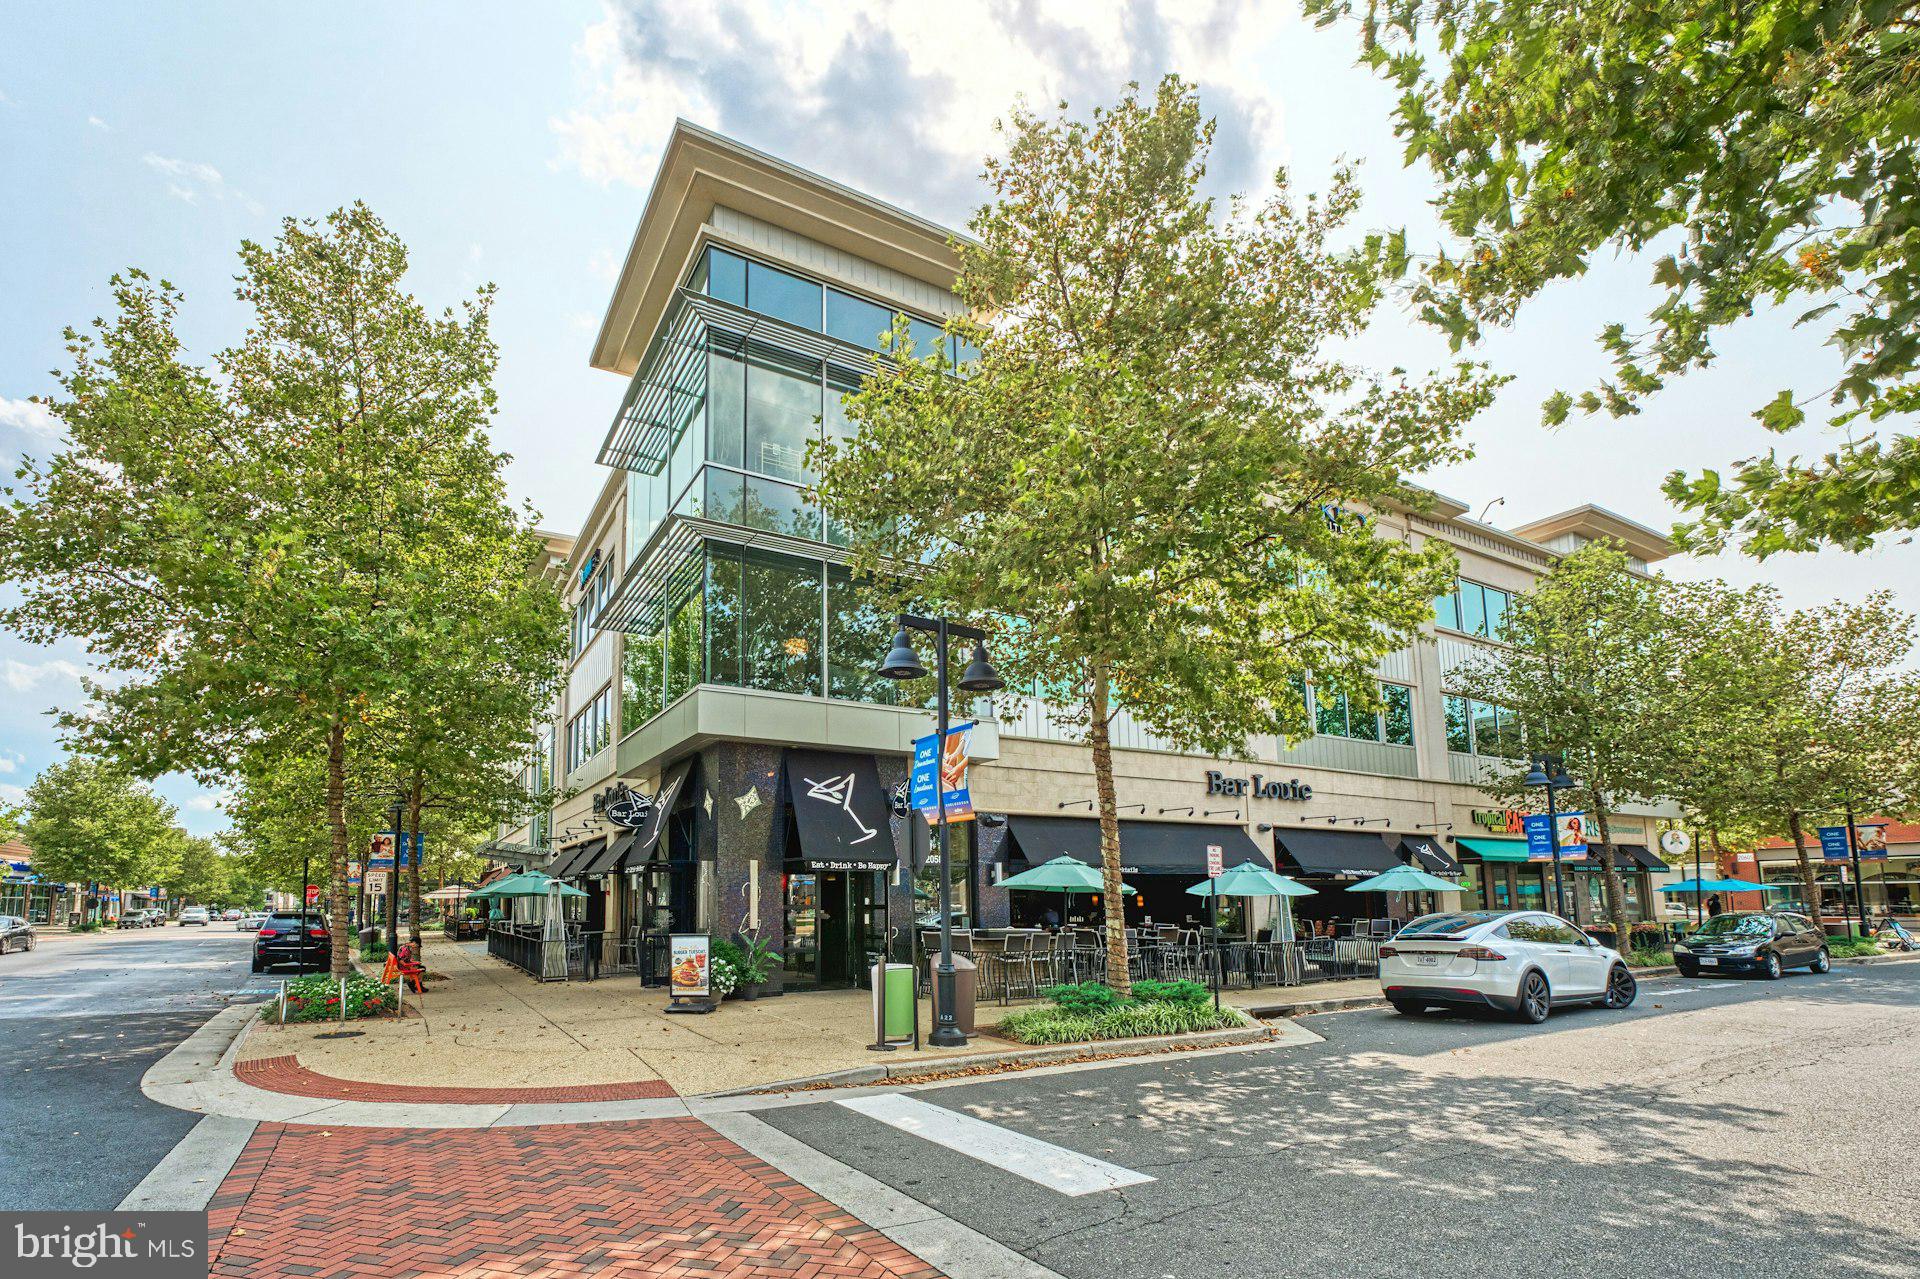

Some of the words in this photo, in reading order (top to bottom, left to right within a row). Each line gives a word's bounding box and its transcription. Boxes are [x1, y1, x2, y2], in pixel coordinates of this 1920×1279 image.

[920, 748, 932, 758] ONE
[917, 773, 930, 783] ONE
[1205, 770, 1249, 796] Bar
[1251, 773, 1313, 800] Louie
[895, 801, 903, 809] Bar
[629, 810, 648, 818] Loui
[1472, 810, 1506, 826] tropical
[1506, 809, 1529, 833] CAF
[868, 862, 888, 870] Happy
[369, 883, 382, 892] 15
